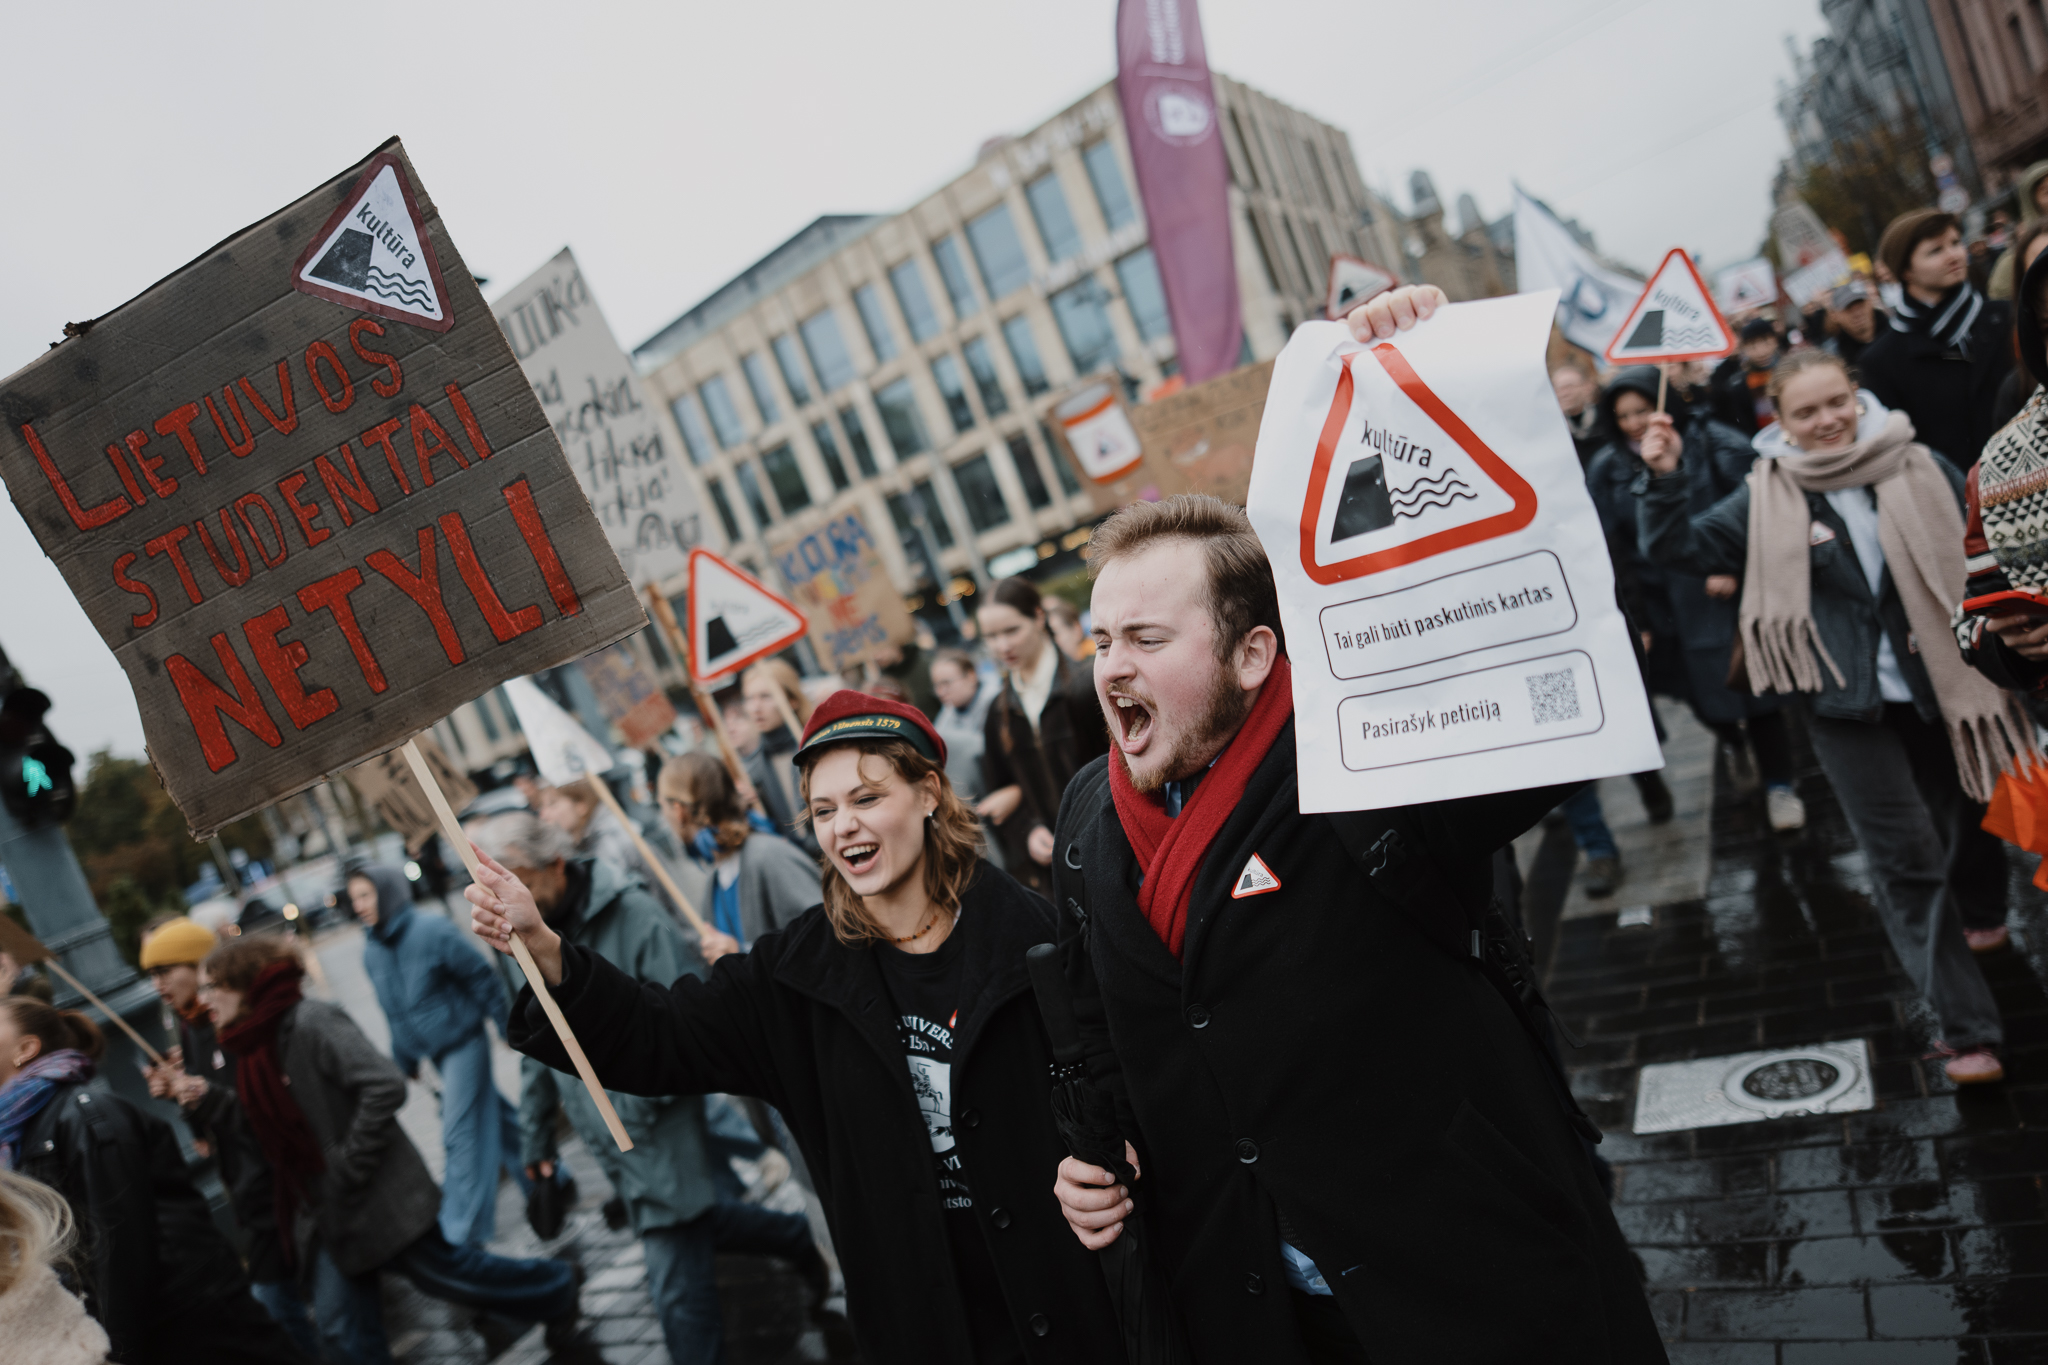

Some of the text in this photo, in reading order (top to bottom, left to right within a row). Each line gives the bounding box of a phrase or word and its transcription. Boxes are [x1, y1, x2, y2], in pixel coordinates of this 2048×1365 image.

[356, 202, 416, 269] kultūra
[21, 318, 403, 531] LIETUVOS
[1361, 420, 1432, 468] kultūra
[112, 379, 493, 629] STUDENTAI
[164, 476, 584, 773] NETYLI
[1334, 586, 1553, 650] Tai gali būti paskutinis kartas
[875, 718, 901, 729] 1579
[1362, 700, 1502, 740] Pasirašyk peticiją
